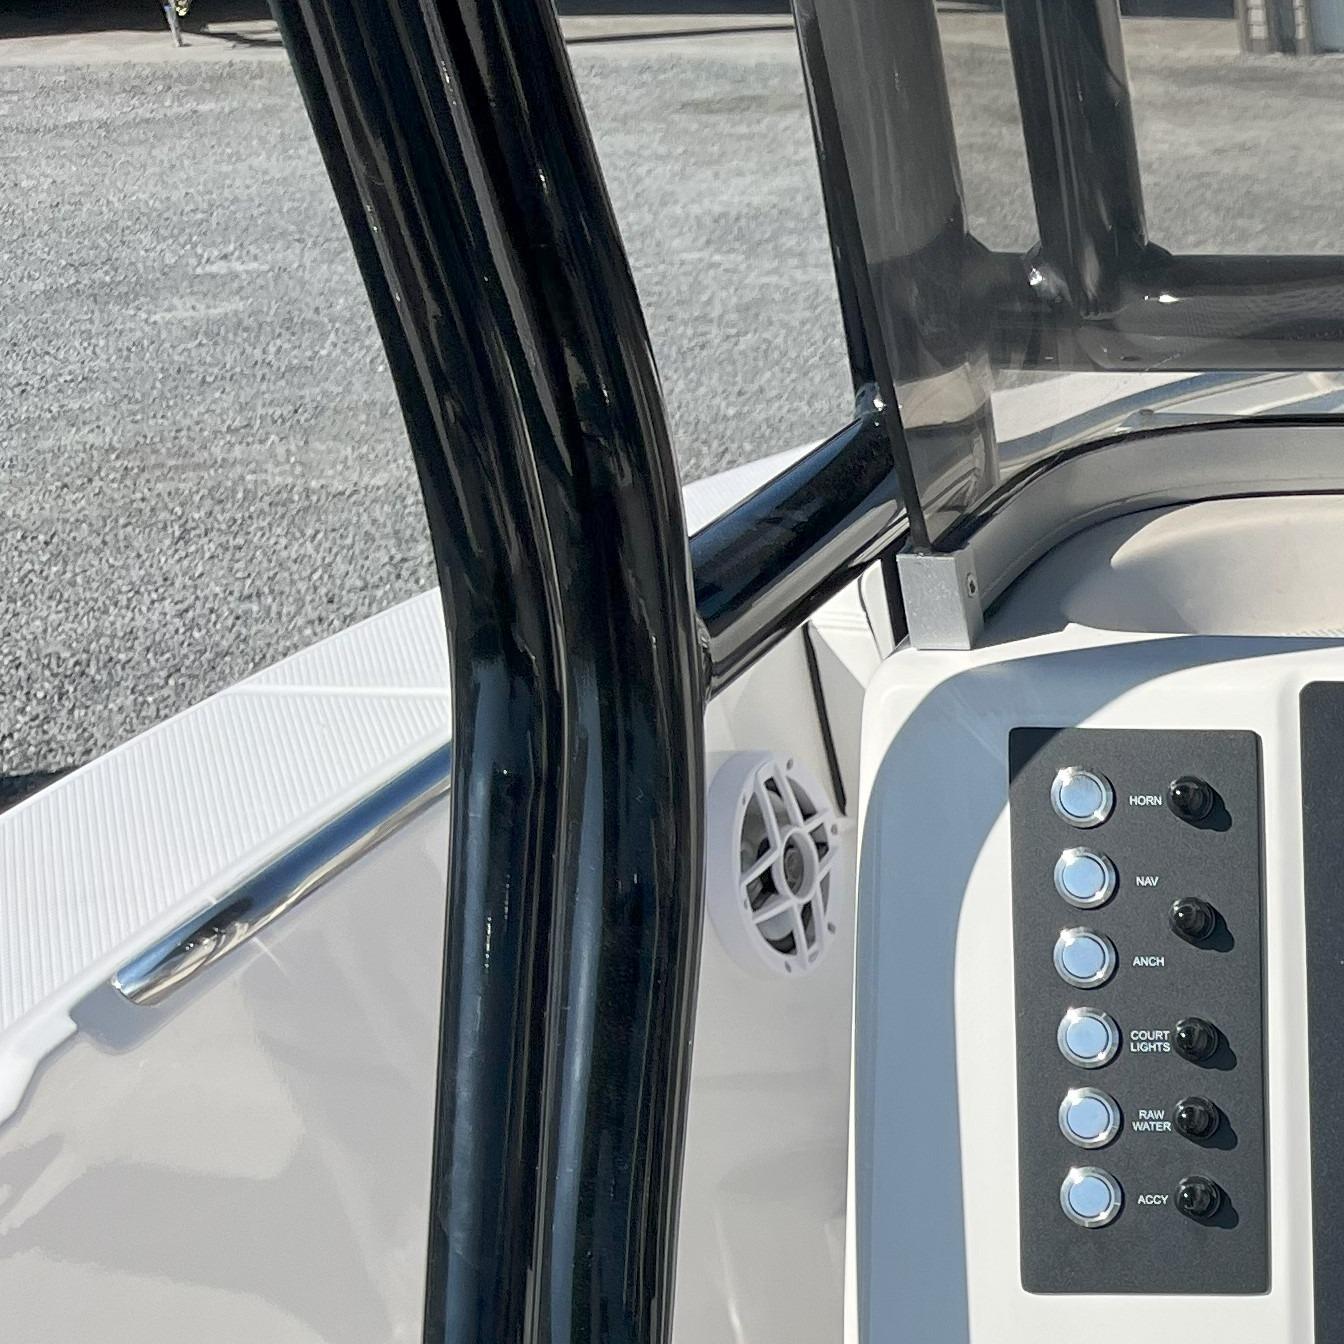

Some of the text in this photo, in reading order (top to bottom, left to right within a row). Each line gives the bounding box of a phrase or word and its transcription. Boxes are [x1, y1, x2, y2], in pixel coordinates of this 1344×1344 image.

[1129, 795, 1162, 806] HORN
[1136, 876, 1158, 886] NAV
[1132, 956, 1164, 967] ANCH
[1130, 1030, 1170, 1041] COURT
[1130, 1042, 1170, 1052] LIGHTS
[1139, 1110, 1164, 1120] RAW
[1132, 1122, 1172, 1132] WATER
[1138, 1194, 1168, 1205] ACCY
